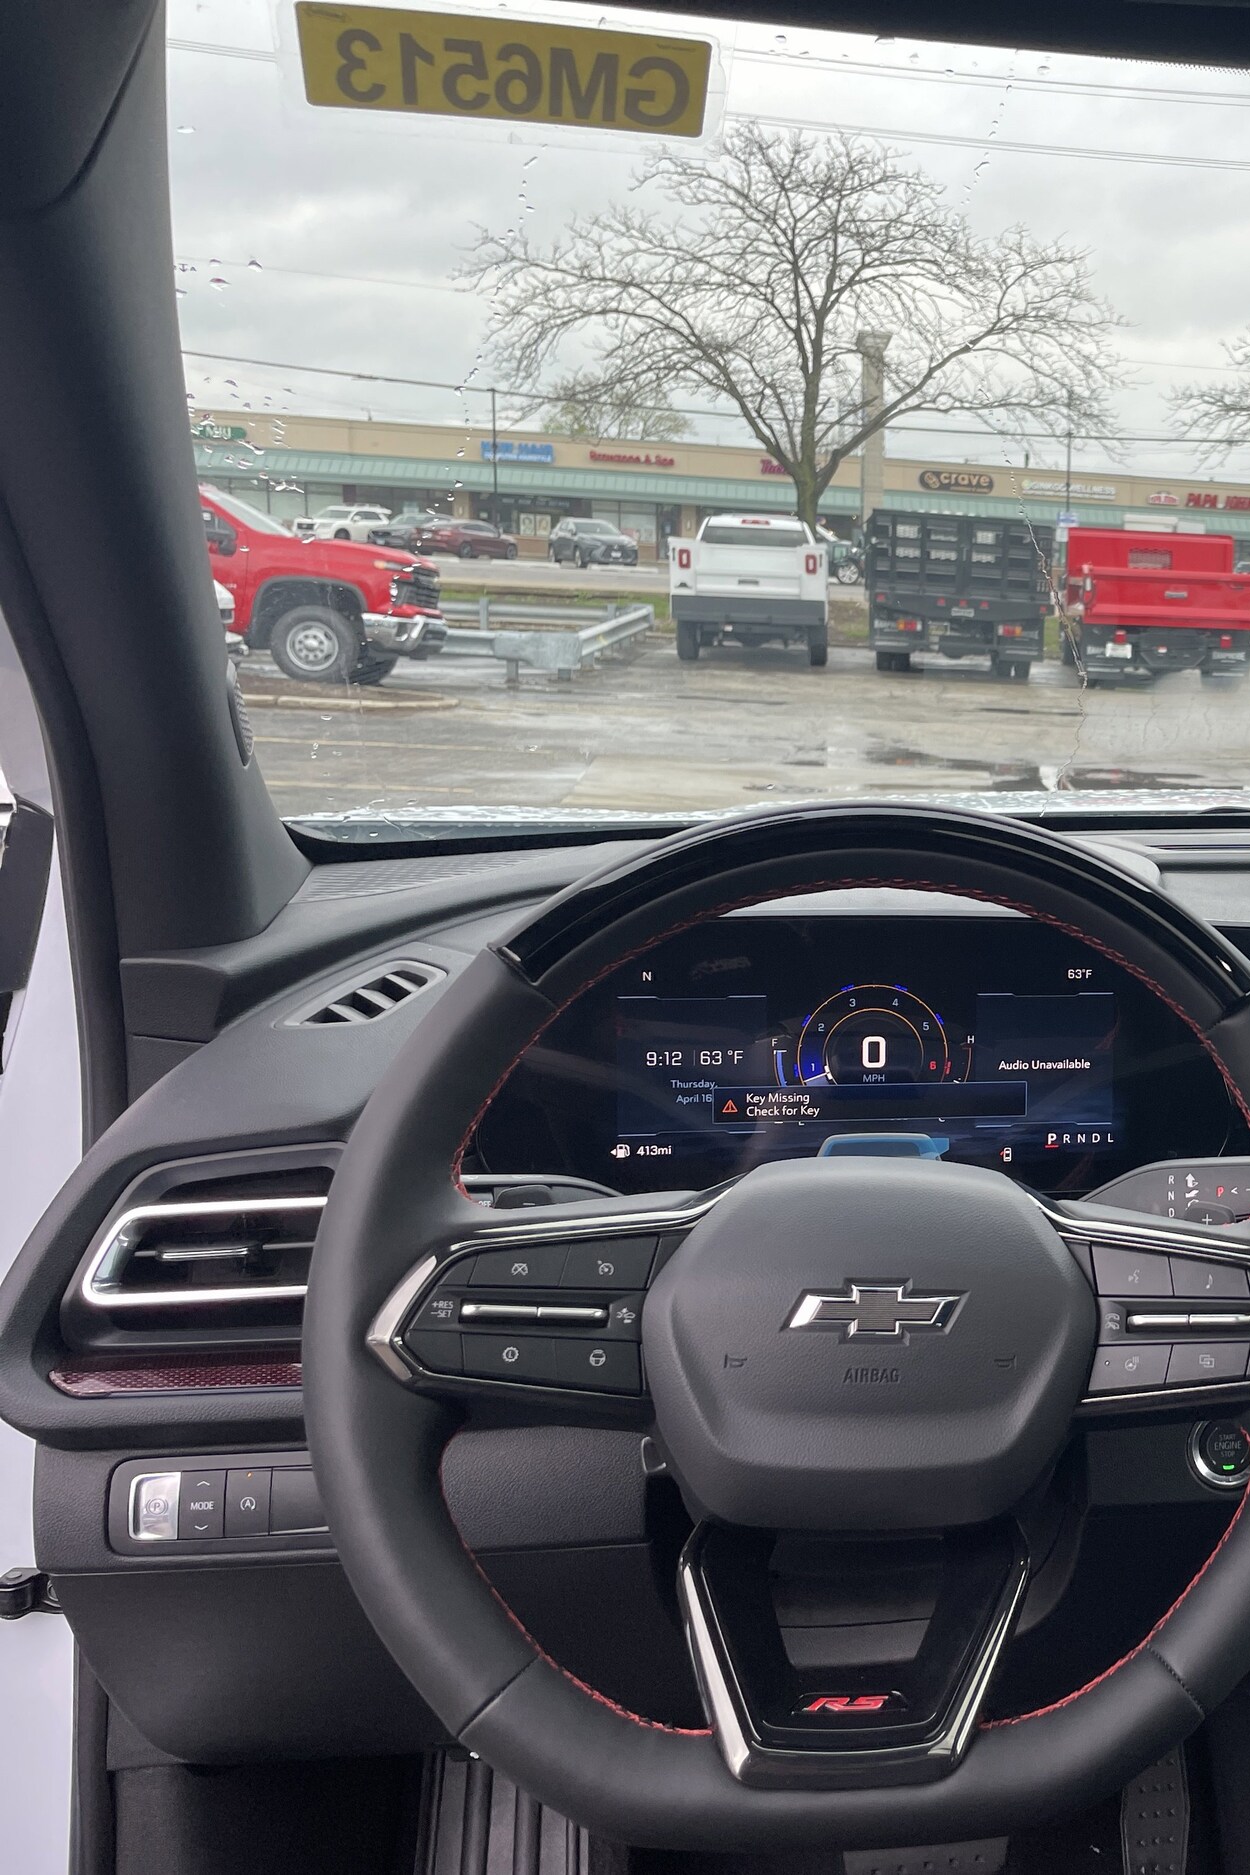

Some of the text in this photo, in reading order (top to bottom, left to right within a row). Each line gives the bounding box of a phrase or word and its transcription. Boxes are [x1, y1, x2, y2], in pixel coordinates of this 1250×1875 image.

[938, 471, 991, 487] crave
[1186, 493, 1219, 509] PAPA
[642, 971, 652, 982] N
[1067, 968, 1093, 979] 63°F
[849, 998, 856, 1008] 3
[892, 998, 899, 1007] 4
[817, 1023, 825, 1032] 2
[922, 1021, 930, 1031] 5
[771, 1038, 778, 1047] F
[967, 1035, 975, 1044] H
[862, 1035, 887, 1069] 0
[646, 1051, 682, 1066] 9:12
[700, 1050, 722, 1065] 63
[810, 1063, 815, 1071] 1
[930, 1061, 936, 1069] 6
[998, 1058, 1091, 1071] Audio Unavailable
[862, 1073, 885, 1083] MPH
[676, 1094, 699, 1105] April
[746, 1092, 810, 1106] Key Missing
[746, 1103, 820, 1118] Check for Key
[1047, 1132, 1114, 1146] P R N D L
[636, 1145, 672, 1156] 413mi
[1168, 1175, 1175, 1184] R
[1168, 1191, 1175, 1200] N
[1216, 1186, 1224, 1197] P
[1168, 1207, 1175, 1217] D
[843, 1367, 900, 1384] AIRBAG
[1214, 1441, 1241, 1451] ENGINE
[190, 1501, 214, 1511] MODE
[803, 1695, 889, 1712] RS
